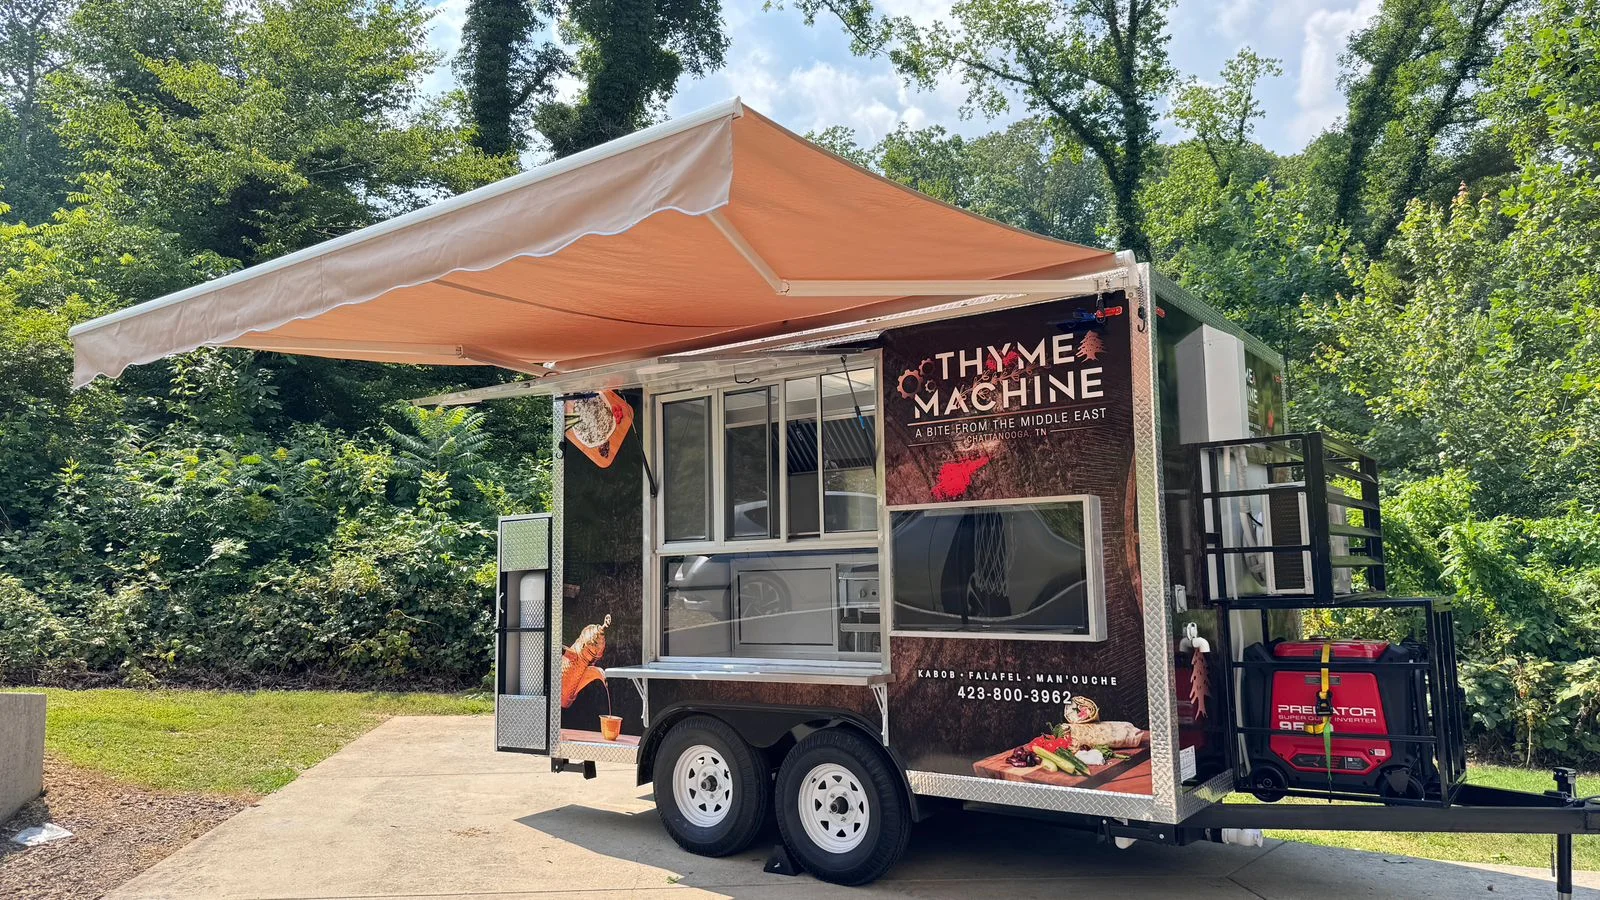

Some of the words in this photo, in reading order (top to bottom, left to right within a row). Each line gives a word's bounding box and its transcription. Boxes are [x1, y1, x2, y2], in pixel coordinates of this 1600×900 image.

[935, 333, 1075, 380] THYME
[914, 367, 1104, 419] MACHINE
[915, 428, 922, 438] A
[926, 425, 950, 437] BITE
[955, 421, 988, 433] FROM
[993, 417, 1015, 429] THE
[1021, 412, 1068, 426] MIDDLE
[1074, 407, 1107, 421] EAST
[1035, 428, 1047, 437] TN
[918, 669, 955, 679] KABOB
[969, 671, 1022, 682] FALAFEL
[1036, 674, 1118, 686] MAN'OUCHE
[957, 686, 1072, 704] 423-800-3962
